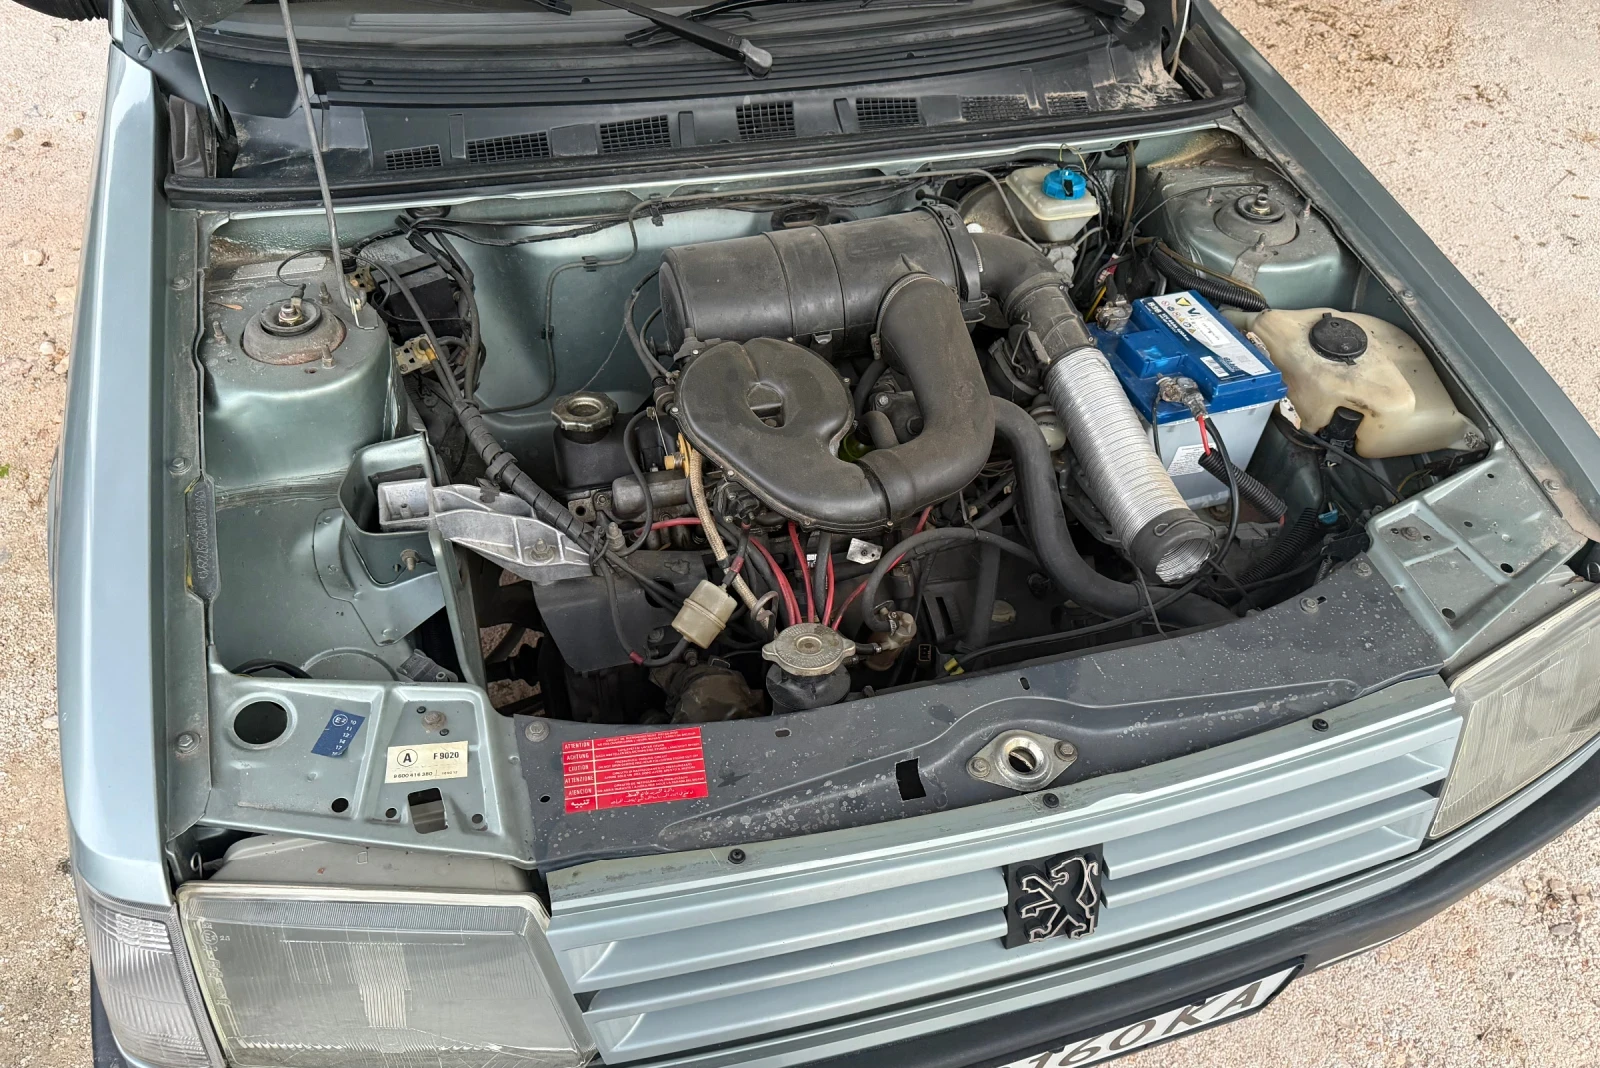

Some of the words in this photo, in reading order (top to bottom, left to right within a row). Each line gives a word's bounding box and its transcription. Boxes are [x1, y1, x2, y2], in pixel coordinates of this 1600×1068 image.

[564, 741, 590, 750] ATTENTION
[402, 752, 412, 764] A
[566, 752, 589, 761] ACHTUNG
[568, 764, 589, 772] CAUTION
[564, 775, 594, 784] ATTENZIONE
